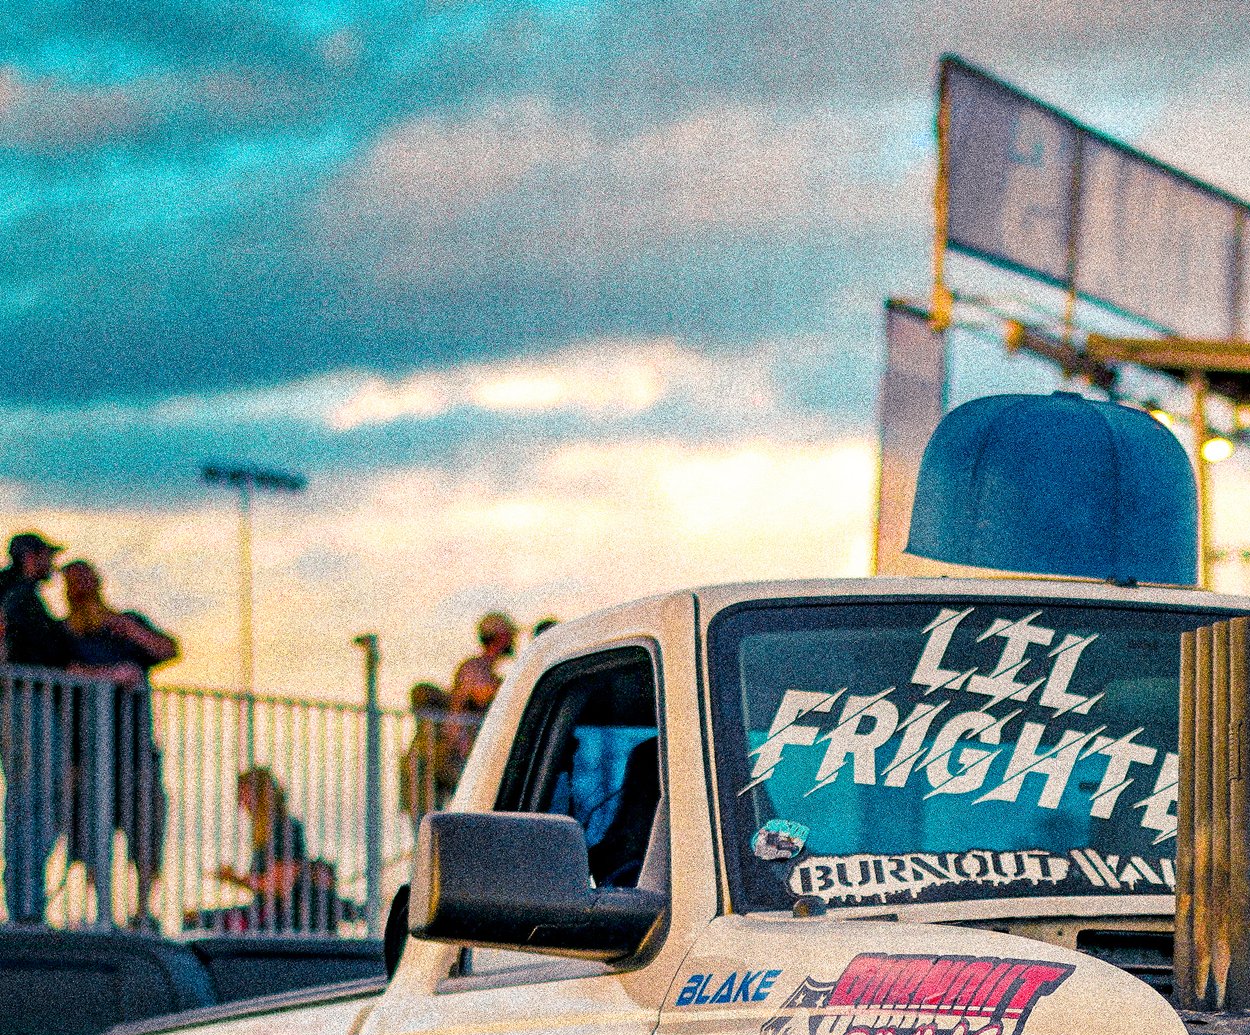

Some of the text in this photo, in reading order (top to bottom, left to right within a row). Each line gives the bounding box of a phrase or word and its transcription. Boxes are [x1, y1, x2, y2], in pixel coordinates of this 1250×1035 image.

[908, 607, 1105, 717] LIL
[798, 852, 1058, 895] BURNOUT
[675, 968, 783, 1007] BLAKE
